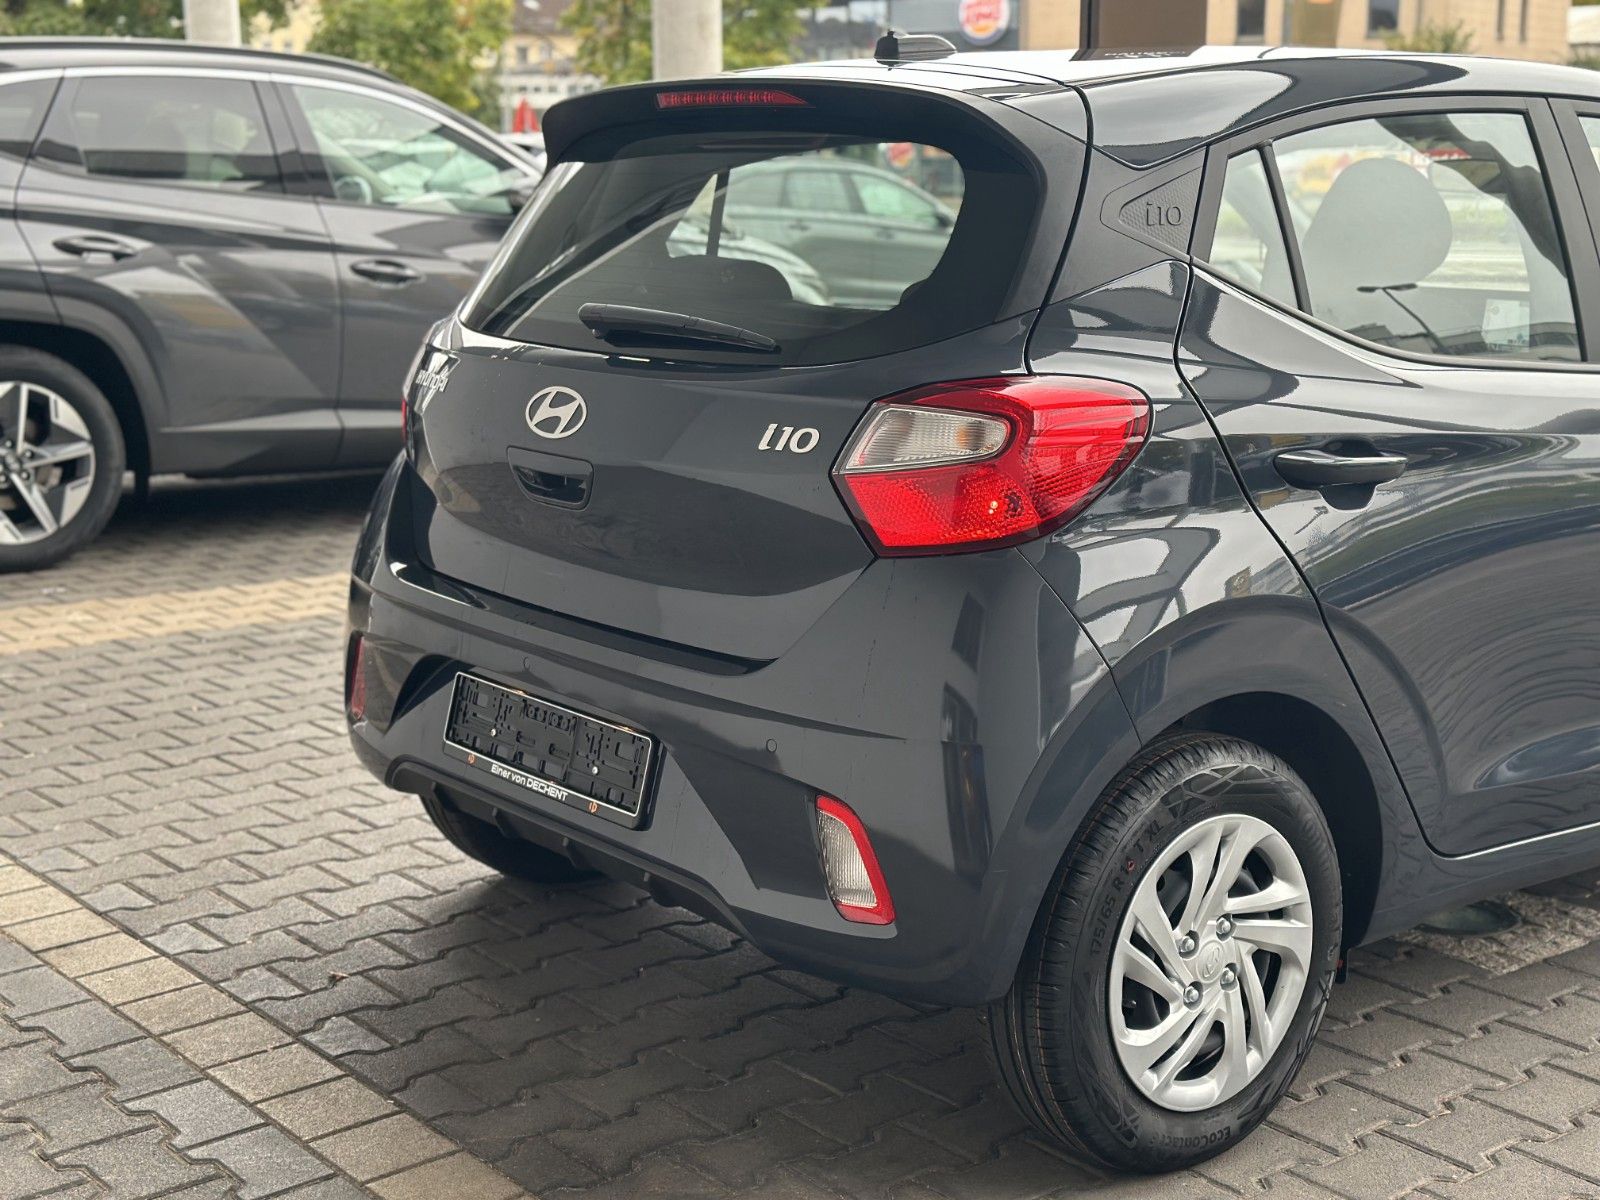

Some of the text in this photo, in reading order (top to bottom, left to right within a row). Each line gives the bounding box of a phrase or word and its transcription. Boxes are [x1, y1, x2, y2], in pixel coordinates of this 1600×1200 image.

[1146, 201, 1182, 227] i10
[490, 763, 569, 802] Einer von DECHENT
[1112, 876, 1125, 891] R
[1161, 1126, 1231, 1148] EcoContact
